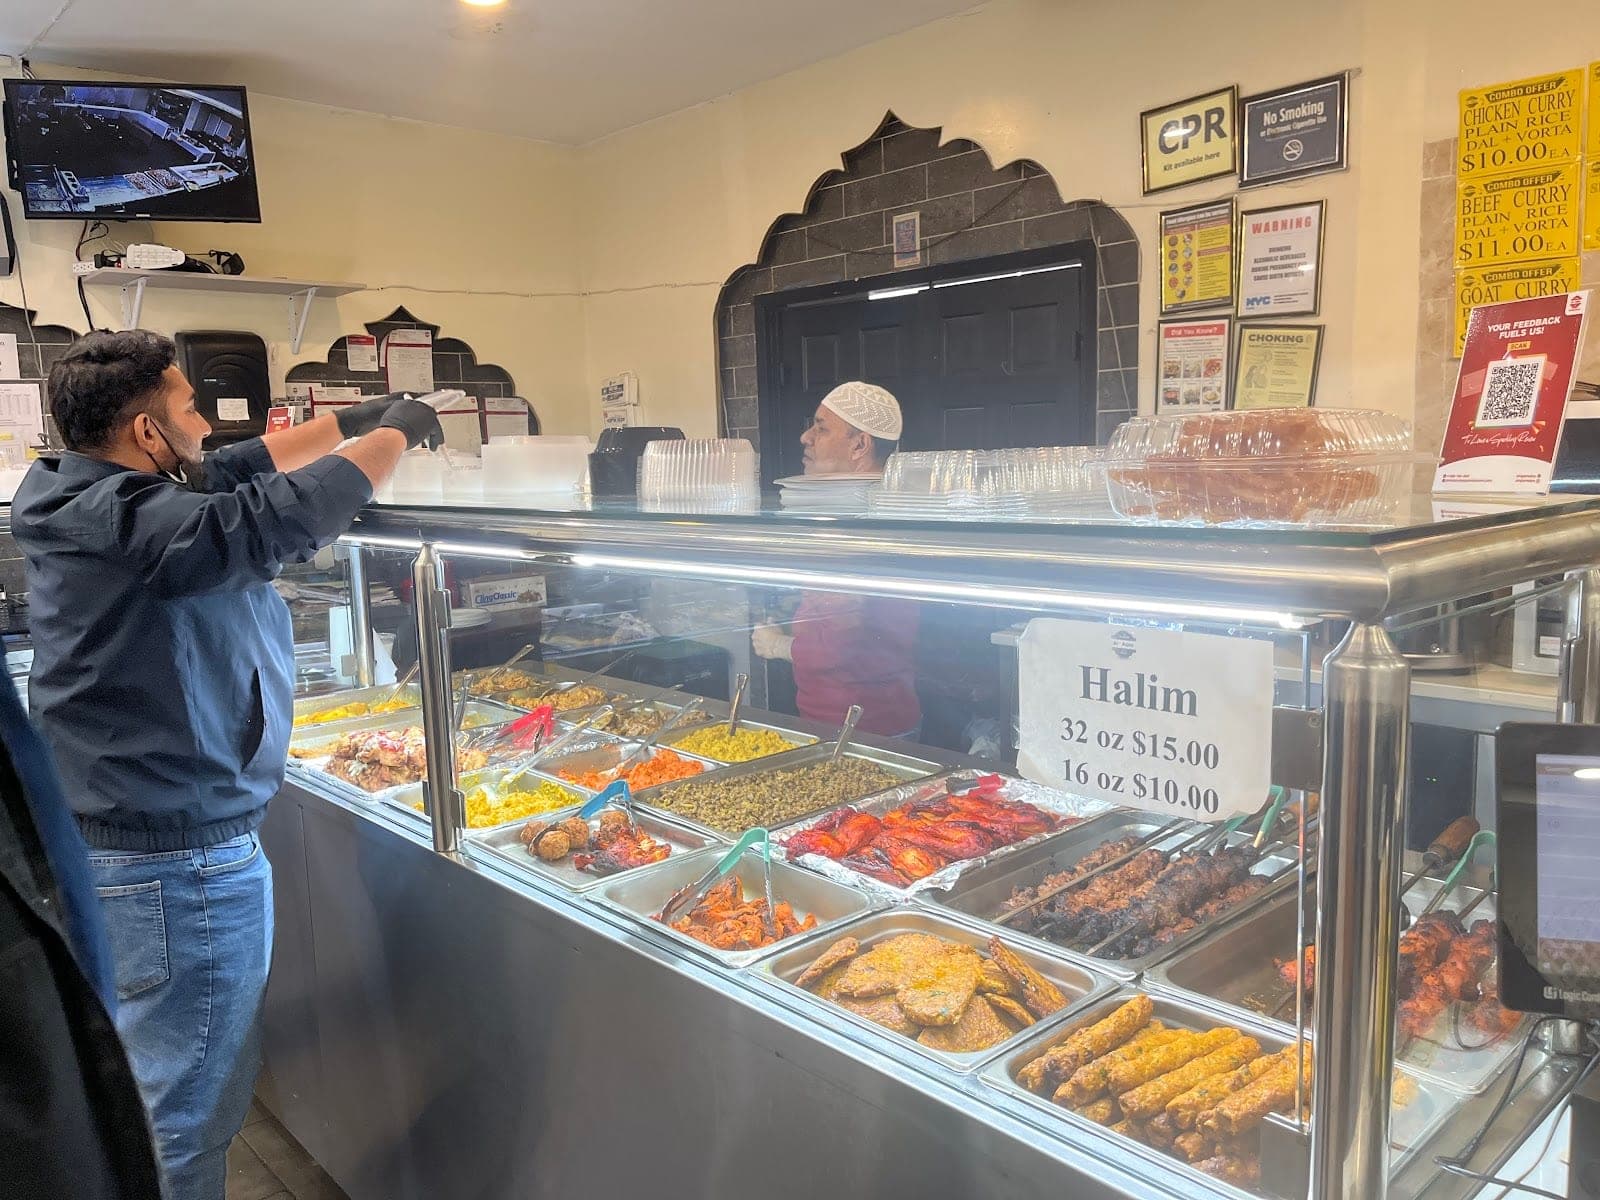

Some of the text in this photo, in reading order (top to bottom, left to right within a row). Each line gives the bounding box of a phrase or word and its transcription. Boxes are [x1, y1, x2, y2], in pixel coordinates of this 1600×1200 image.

[1489, 81, 1557, 101] COMBO OFFER
[1263, 101, 1325, 127] No Smoking
[1463, 89, 1575, 126] CHICKEN CURRY
[1158, 106, 1227, 155] CPR
[1465, 111, 1572, 139] PLAIN RICE
[1467, 137, 1498, 151] DAL
[1517, 124, 1572, 142] VORTA
[1461, 142, 1547, 172] $10.00
[1487, 174, 1553, 192] COMBO OFFER
[1462, 194, 1502, 216] BEEF
[1513, 184, 1572, 208] CURRY
[1251, 216, 1312, 235] WARNING
[1463, 204, 1568, 228] PLAIN RICE
[1464, 227, 1496, 241] DAL
[1513, 218, 1569, 233] VORTA
[1459, 234, 1544, 261] $11.00
[1485, 267, 1553, 282] COMBO OFFER
[1246, 296, 1271, 306] NYC
[1460, 278, 1572, 305] GOAT CURRY
[1487, 315, 1561, 333] YOUR FEEDBACK
[1499, 326, 1545, 340] FUELS US!
[1248, 334, 1304, 343] CHOKING
[1077, 664, 1198, 717] Halim
[1060, 717, 1219, 770] 32 oz $15.00
[1062, 758, 1219, 814] 16 oz $10.00
